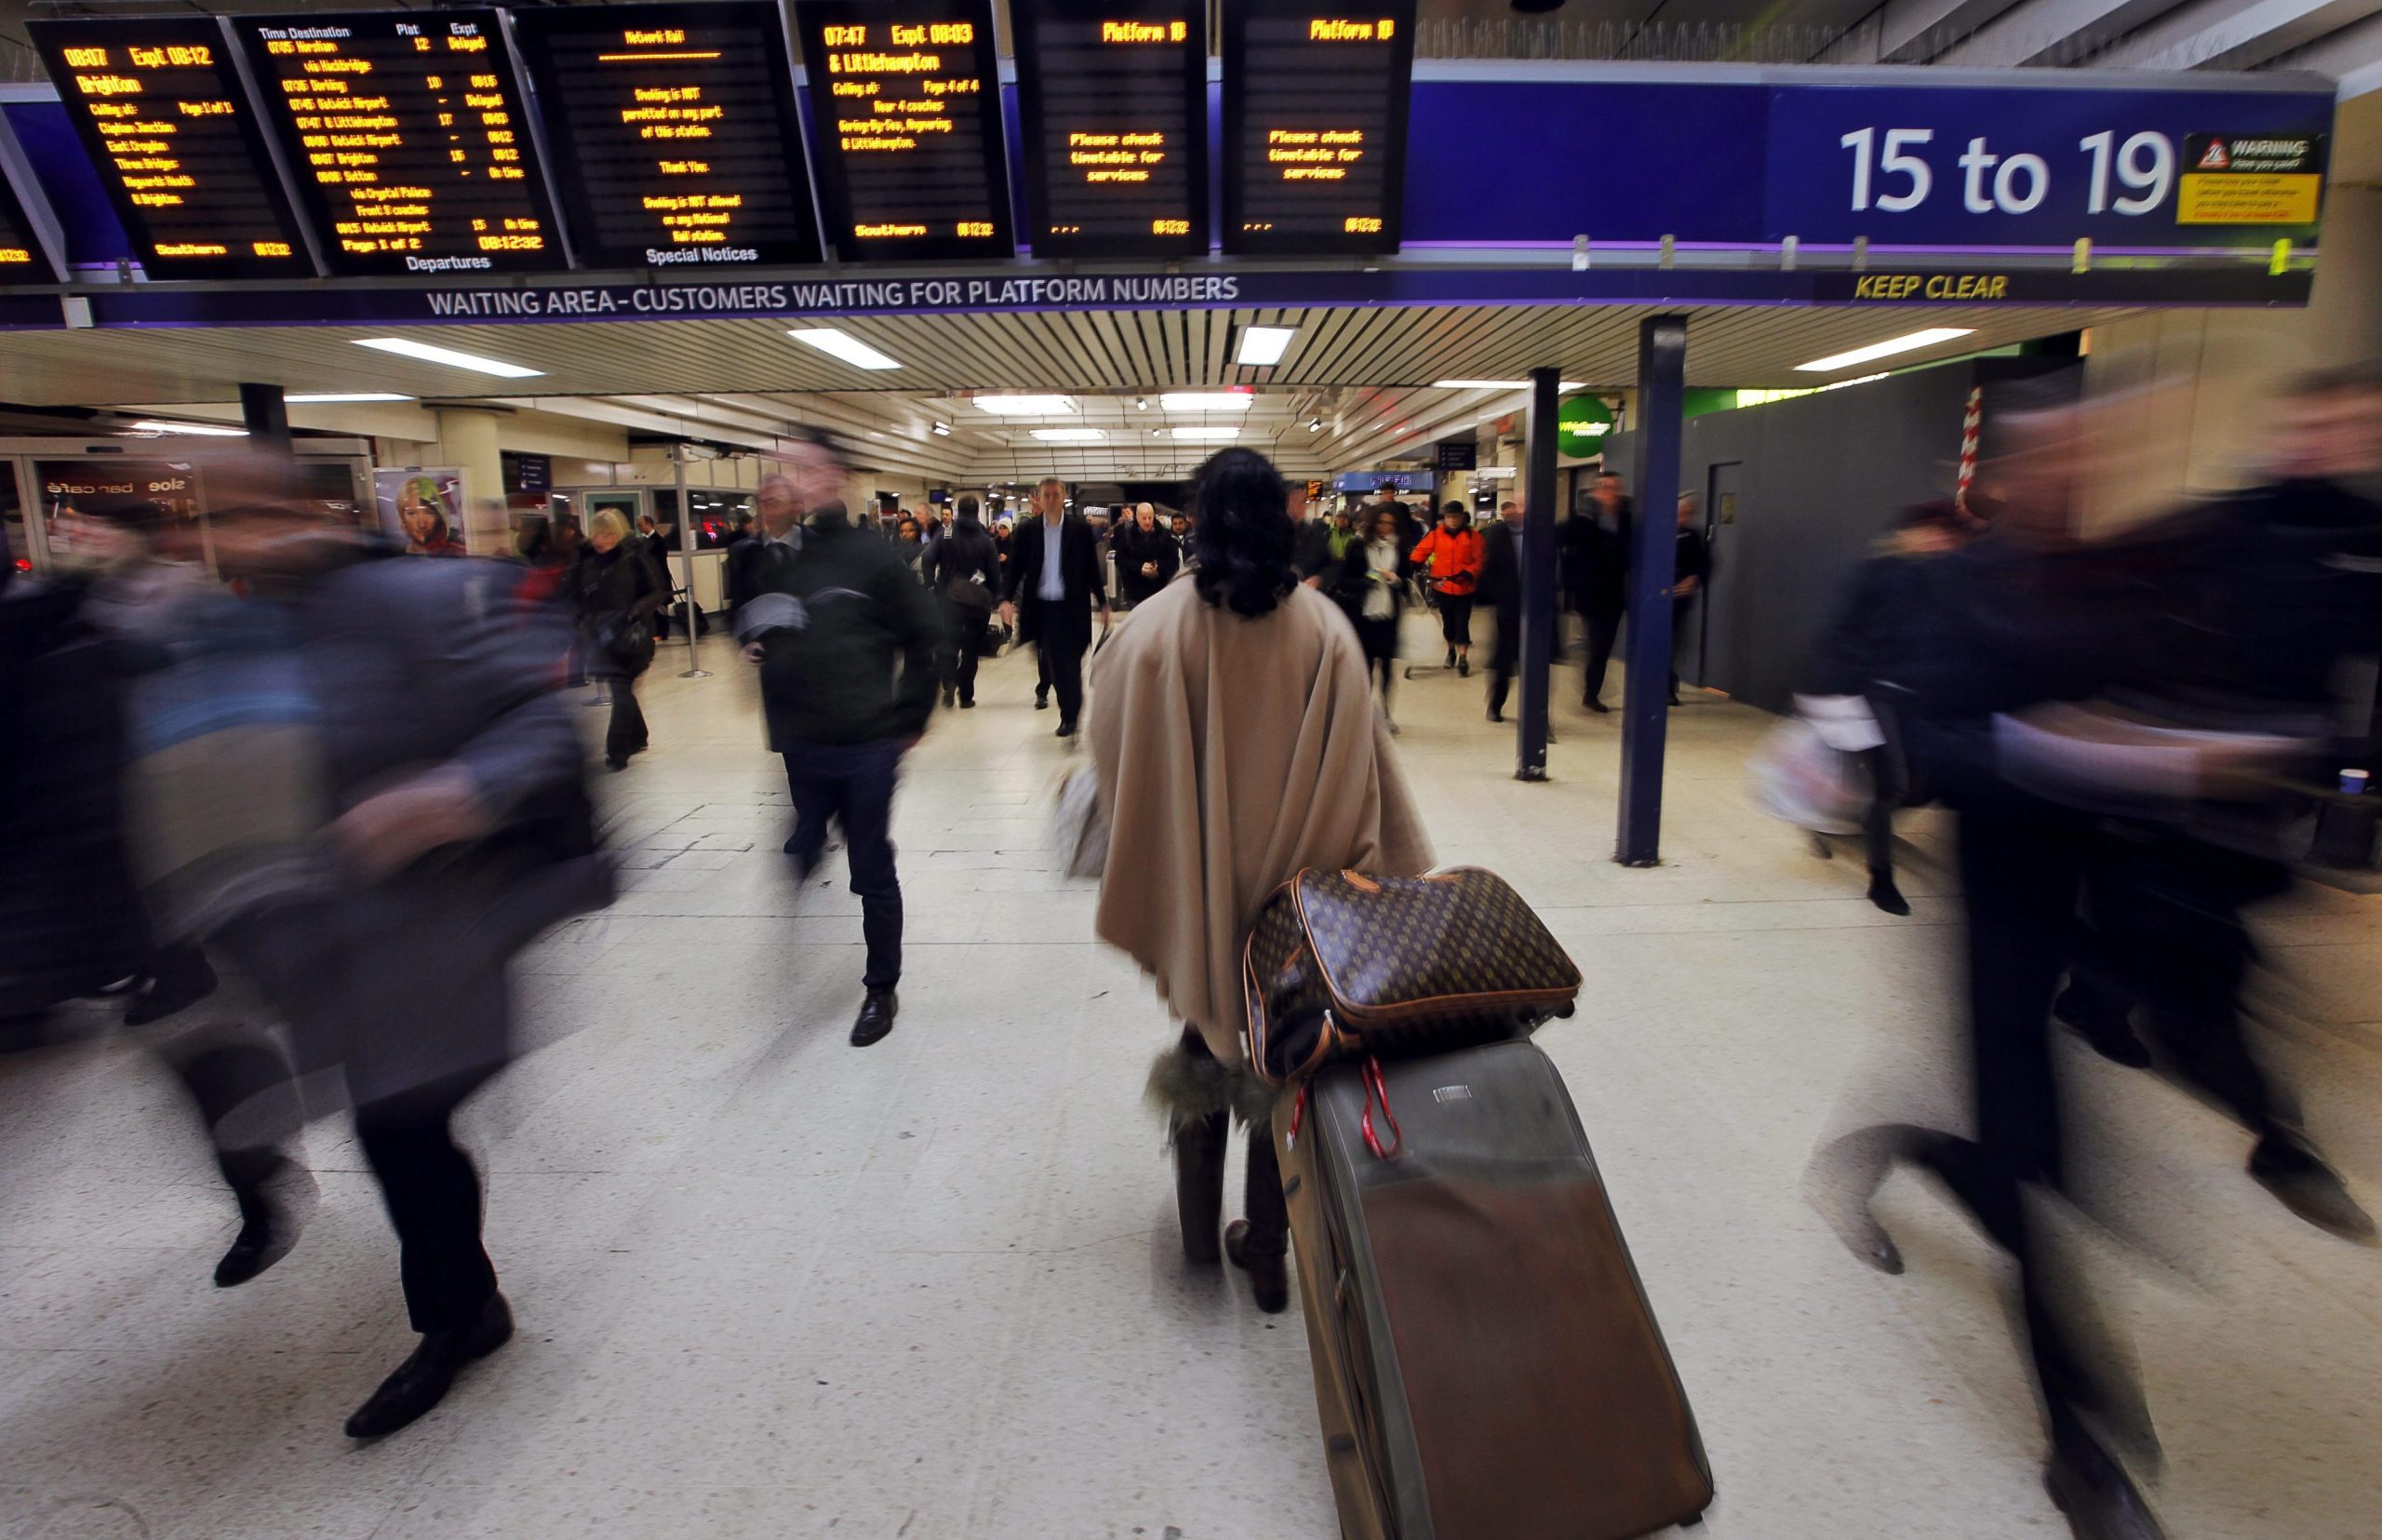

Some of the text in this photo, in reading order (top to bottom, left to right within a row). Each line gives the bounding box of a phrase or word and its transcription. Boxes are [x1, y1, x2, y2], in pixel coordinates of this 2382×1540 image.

[259, 22, 478, 40] Time Destination Plat Expt
[624, 30, 685, 45] Network Rail
[824, 26, 866, 46] 07:47
[930, 24, 974, 44] 08:03
[1103, 21, 1166, 43] Platform
[1310, 20, 1373, 41] Platform
[296, 40, 338, 53] Horsham
[415, 37, 431, 50] 12
[448, 36, 487, 51] Delayed
[63, 48, 108, 66] 08:07
[167, 47, 213, 65] 08:12
[829, 52, 941, 74] & Littlehampton
[76, 75, 142, 95] Brighton
[310, 79, 348, 94] Dorking
[833, 82, 865, 97] Calling
[923, 80, 948, 95] Page
[946, 79, 957, 93] 4
[957, 79, 970, 93] of
[970, 78, 980, 92] 4
[635, 88, 672, 102] Smoking
[681, 87, 701, 100] NOT
[179, 101, 204, 116] Page
[317, 98, 354, 109] Gatwick
[353, 97, 390, 111] Airport
[465, 94, 503, 108] Delayed
[873, 99, 945, 113] Rear 4 coaches
[439, 114, 453, 126] 17
[622, 107, 668, 123] permitted
[668, 109, 682, 119] on
[681, 109, 700, 121] any
[641, 126, 654, 139] of
[654, 125, 676, 138] this
[1070, 132, 1164, 146] Please check
[1269, 130, 1363, 143] Please check
[105, 141, 169, 154] East Croydon
[330, 135, 366, 147] Gatwick
[365, 134, 402, 148] Airport
[2230, 140, 2309, 156] WARNING
[336, 153, 379, 167] Brighton
[1070, 151, 1165, 164] timetable for
[1268, 148, 1363, 162] timetable for
[343, 170, 378, 181] Sutton
[488, 167, 504, 179] On
[502, 167, 525, 178] time
[659, 161, 689, 174] Thank
[1087, 169, 1150, 181] services
[1283, 166, 1346, 179] services
[1840, 127, 2176, 217] 15 to 19
[643, 196, 678, 210] Smoking
[688, 195, 707, 208] NOT
[362, 222, 397, 234] Gatwick
[396, 221, 432, 234] Airport
[472, 220, 487, 231] 15
[504, 219, 518, 230] On
[516, 218, 539, 230] time
[662, 212, 730, 227] on any National
[672, 230, 691, 242] Rail
[854, 225, 927, 237] Southern
[154, 244, 227, 255] Southern
[341, 235, 543, 252] Page 1 of 2 08:12:32
[646, 246, 759, 266] Special Notices
[405, 256, 493, 274] Departures
[427, 290, 540, 315] WAITING
[793, 282, 904, 309] WAITING
[910, 281, 962, 306] FOR
[968, 278, 1107, 305] PLATFORM
[1113, 275, 1239, 301] NUMBERS
[1854, 275, 2011, 301] KEEP CLEAR
